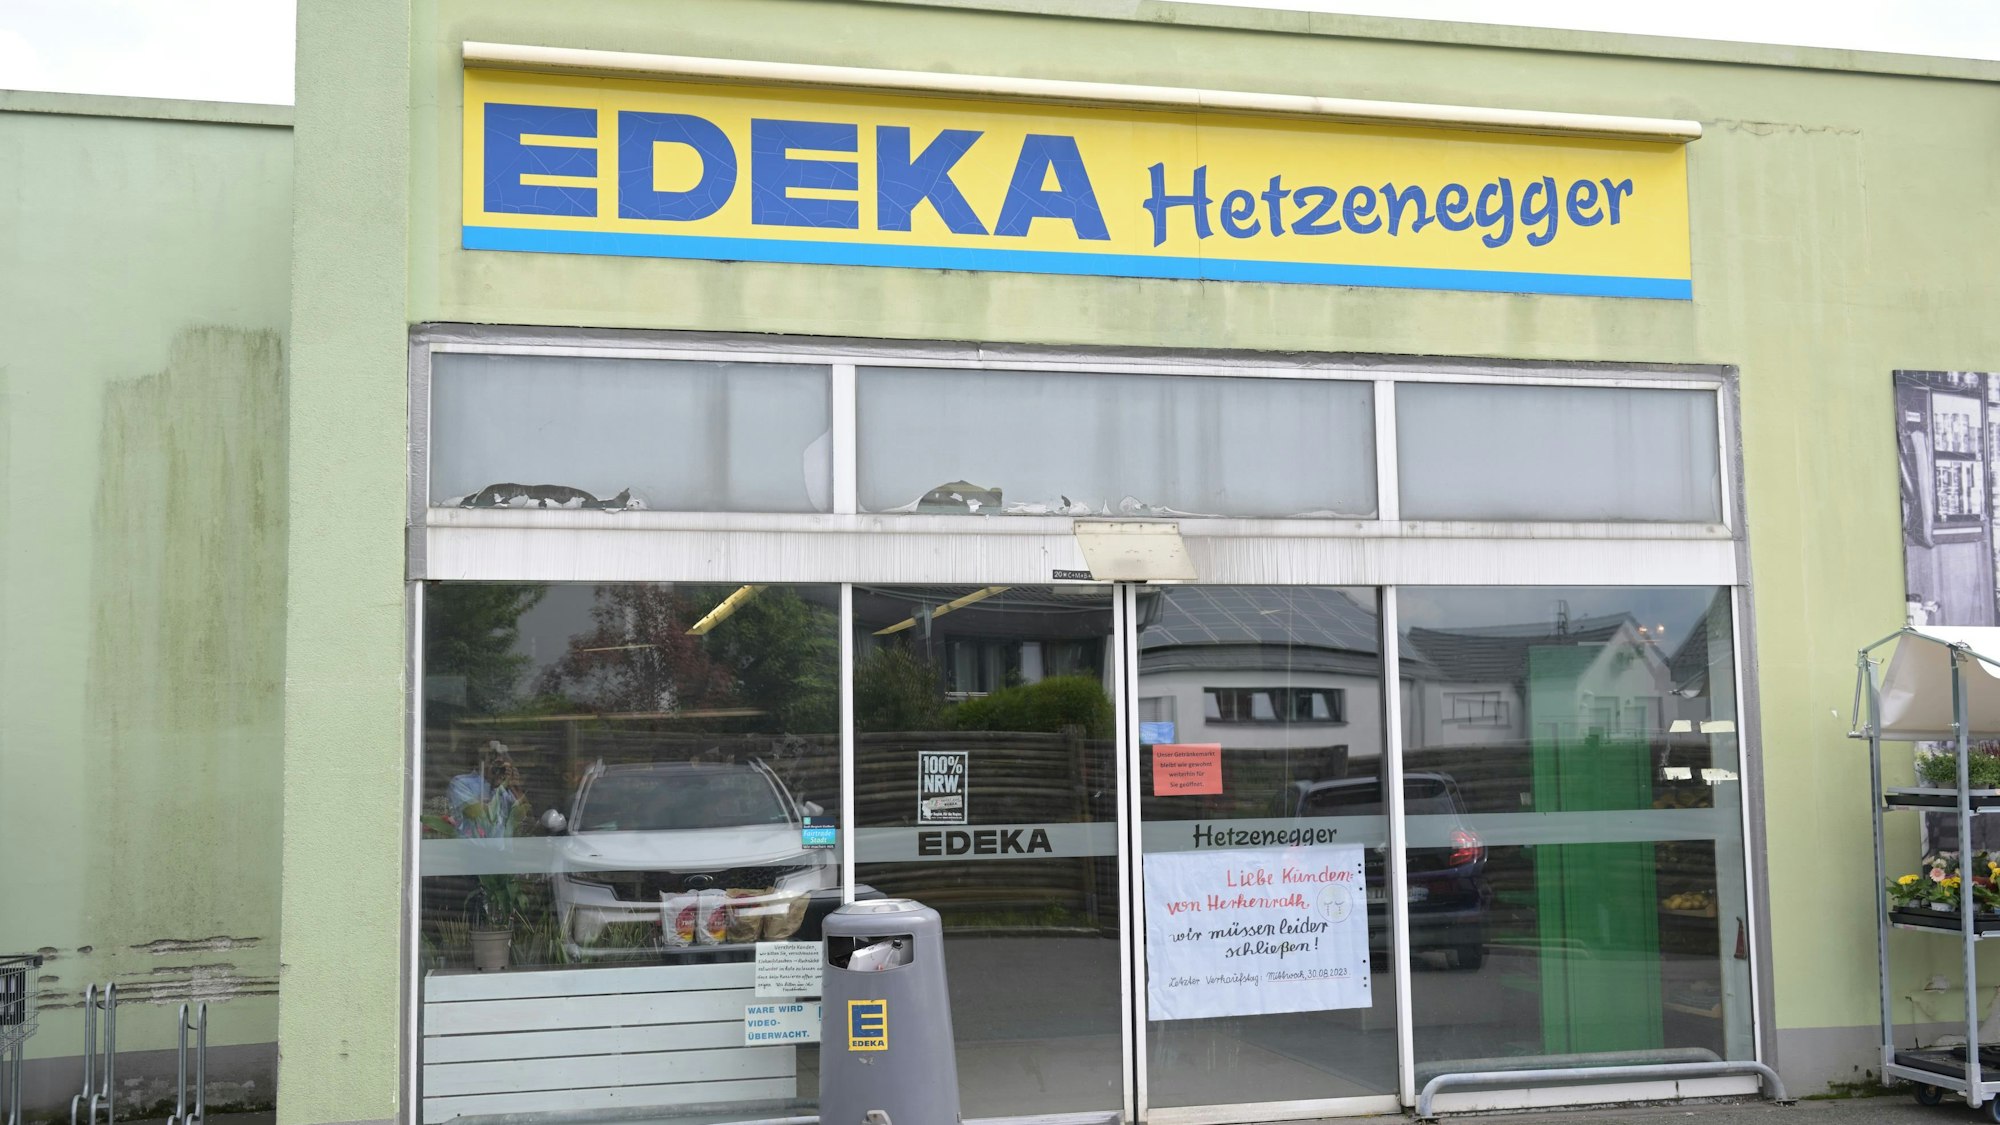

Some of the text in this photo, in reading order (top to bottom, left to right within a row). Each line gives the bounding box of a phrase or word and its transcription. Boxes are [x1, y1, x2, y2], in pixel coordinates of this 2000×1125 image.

[483, 101, 1634, 249] EDEKA Hetzenegger
[923, 755, 963, 774] 100%
[1188, 761, 1213, 769] gewohnt
[924, 774, 962, 793] NRW.
[803, 829, 832, 837] Fairtrade
[918, 828, 1053, 857] EDEKA
[1192, 823, 1338, 848] Hetzenegger
[1227, 868, 1273, 887] Liebe
[1167, 900, 1202, 916] von
[1169, 916, 1329, 943] wir müssen leider
[1168, 975, 1201, 988] Letzter
[747, 1005, 803, 1014] WARE WIRD
[747, 1019, 781, 1027] VIDEO-
[852, 1004, 884, 1037] E
[748, 1030, 810, 1041] ÜBERWACHT.
